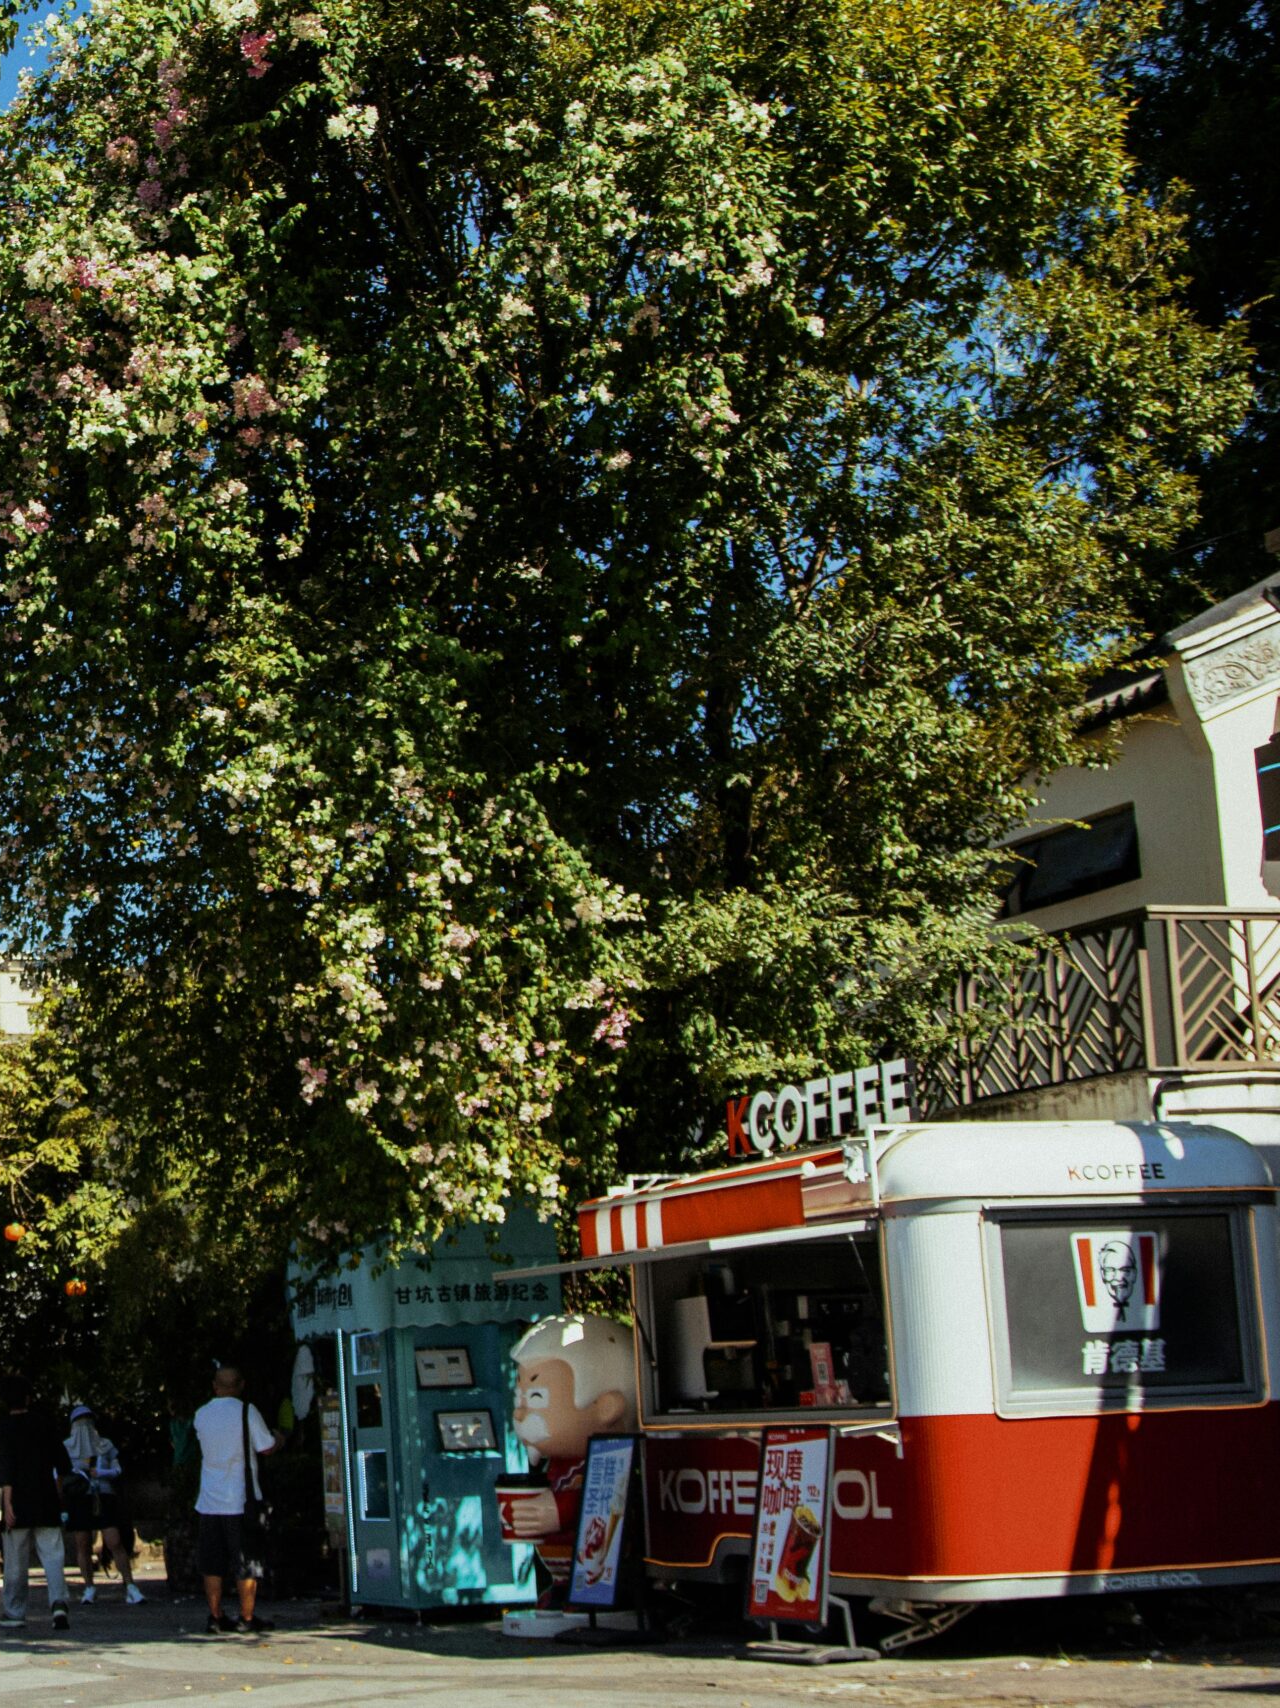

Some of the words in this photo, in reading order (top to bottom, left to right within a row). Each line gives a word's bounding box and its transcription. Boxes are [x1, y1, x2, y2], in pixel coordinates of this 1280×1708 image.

[726, 1058, 912, 1157] KCOFFEE
[1067, 1163, 1166, 1181] KCOFFEE
[394, 1282, 550, 1305] 甘坑古镇旅游纪念
[1081, 1339, 1167, 1376] 肯德基
[765, 1449, 803, 1481] 现磨
[659, 1469, 758, 1514] KOFFE
[833, 1470, 893, 1519] OL
[762, 1484, 802, 1515] 咖啡
